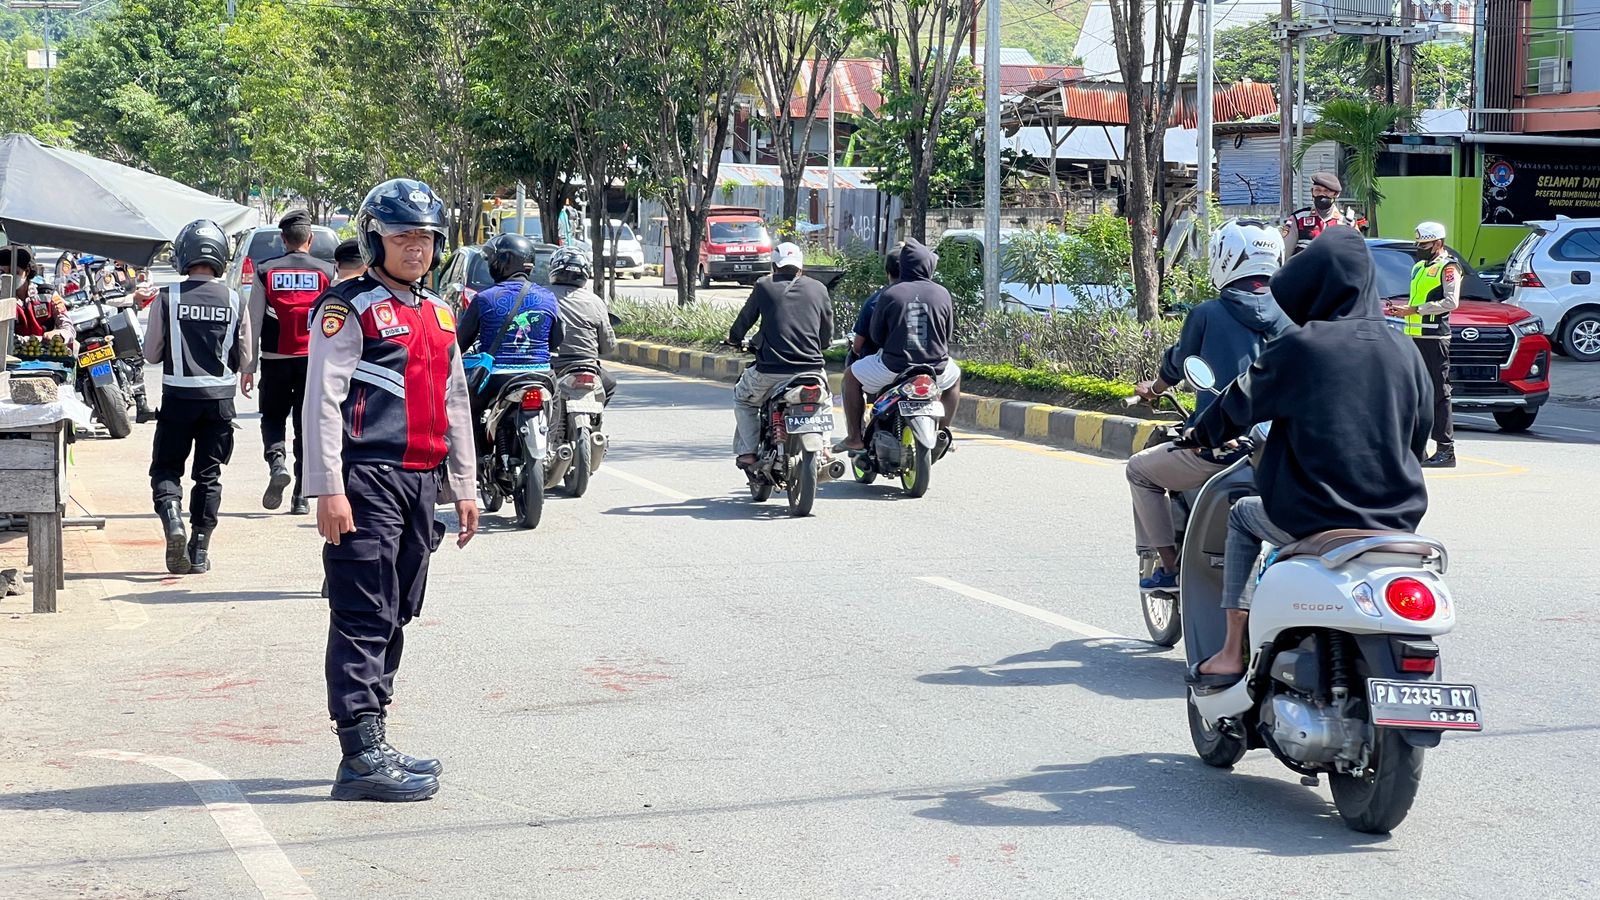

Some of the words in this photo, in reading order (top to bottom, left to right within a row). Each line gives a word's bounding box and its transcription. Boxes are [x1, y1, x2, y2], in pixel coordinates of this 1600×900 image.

[1537, 175, 1580, 188] SELAMAT
[1582, 176, 1600, 188] DAT
[1562, 191, 1597, 199] BIMBINGAN
[274, 273, 317, 289] POLISI
[178, 305, 231, 323] POLISI
[788, 417, 801, 426] PA
[1292, 603, 1344, 612] SCOOPY
[1376, 685, 1397, 704] PA
[1400, 687, 1442, 706] 2335
[1450, 689, 1471, 707] RY
